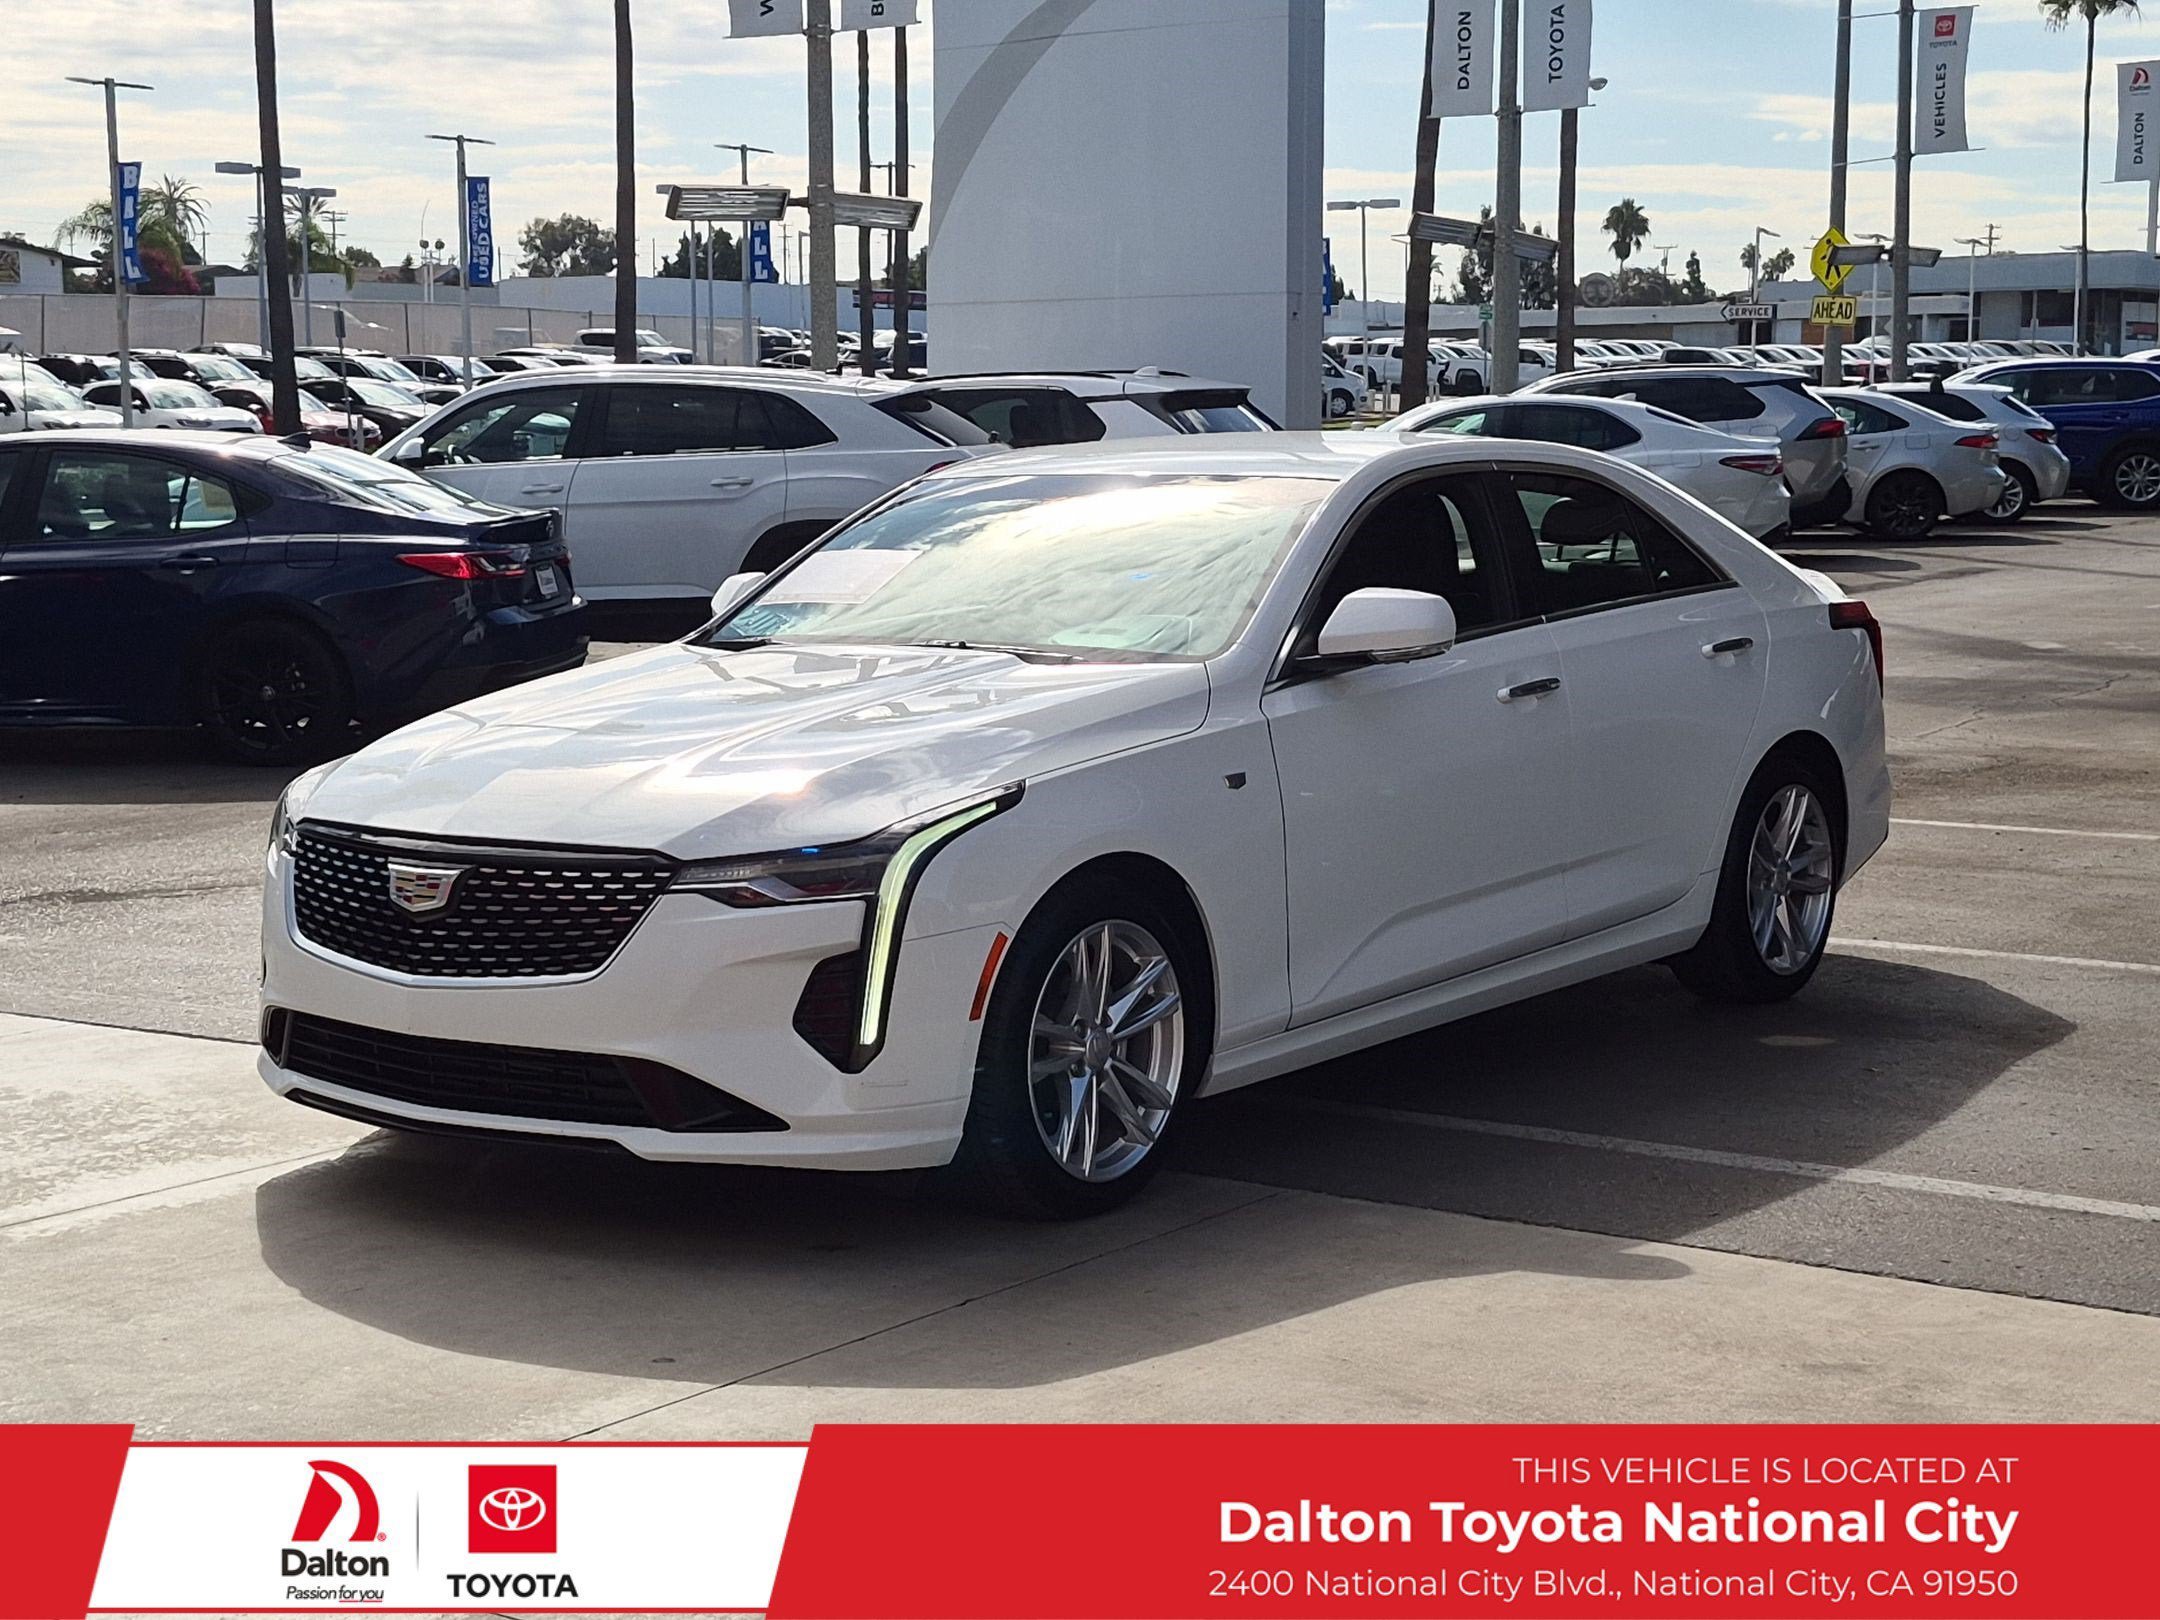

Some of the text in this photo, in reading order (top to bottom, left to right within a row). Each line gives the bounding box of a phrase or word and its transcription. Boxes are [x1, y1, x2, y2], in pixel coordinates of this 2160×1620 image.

[1457, 11, 1472, 90] DALTON
[1548, 4, 1565, 84] TOYOTA
[1929, 40, 1958, 49] TOYOTA
[1934, 62, 1947, 139] VEHICLES
[2133, 112, 2145, 165] DALTON
[477, 182, 491, 279] USED CARS
[1728, 307, 1769, 317] SERVICE
[1813, 301, 1853, 320] AHEAD
